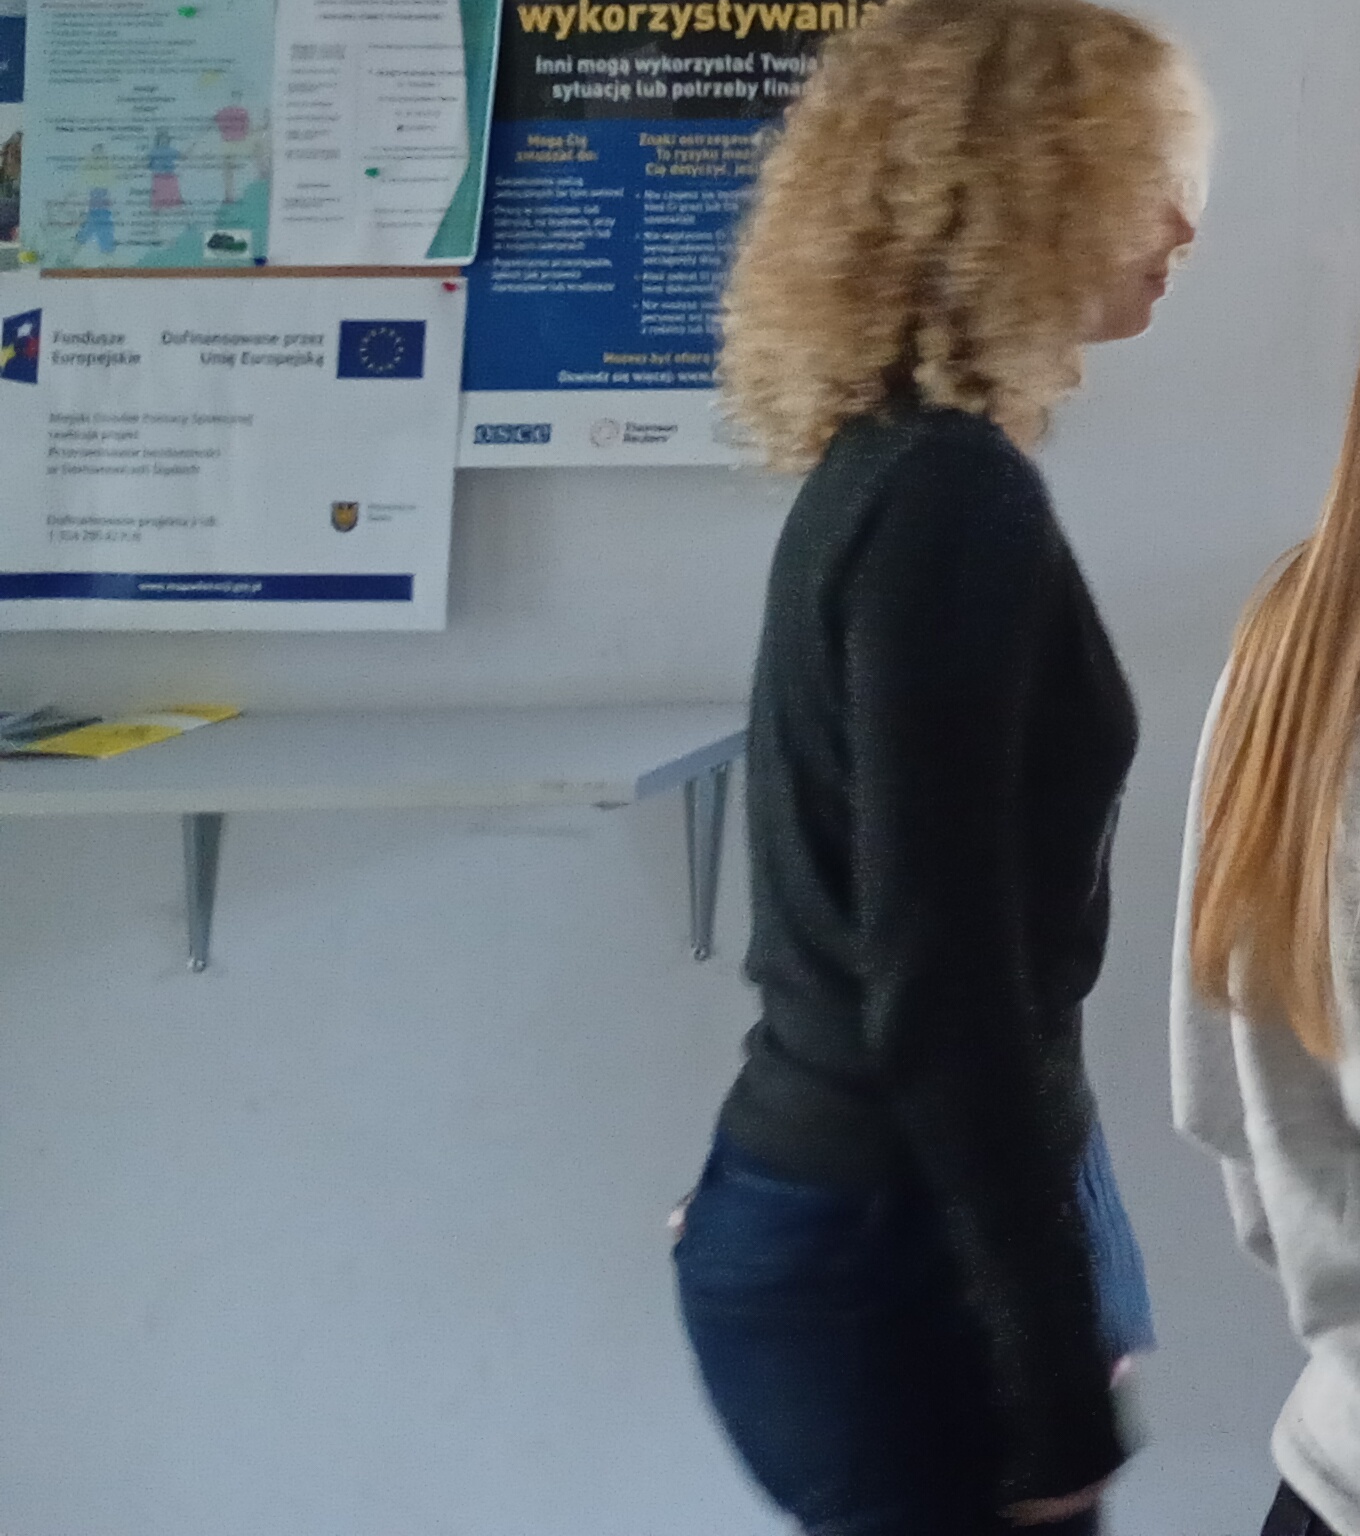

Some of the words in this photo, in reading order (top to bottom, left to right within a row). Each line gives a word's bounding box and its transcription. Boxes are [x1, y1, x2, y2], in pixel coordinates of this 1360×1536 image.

[535, 53, 573, 75] Inni
[577, 58, 630, 78] mogą
[634, 53, 755, 77] wykorzystać
[552, 81, 632, 102] sytuację
[636, 80, 667, 99] lub
[672, 80, 760, 102] potrzeby
